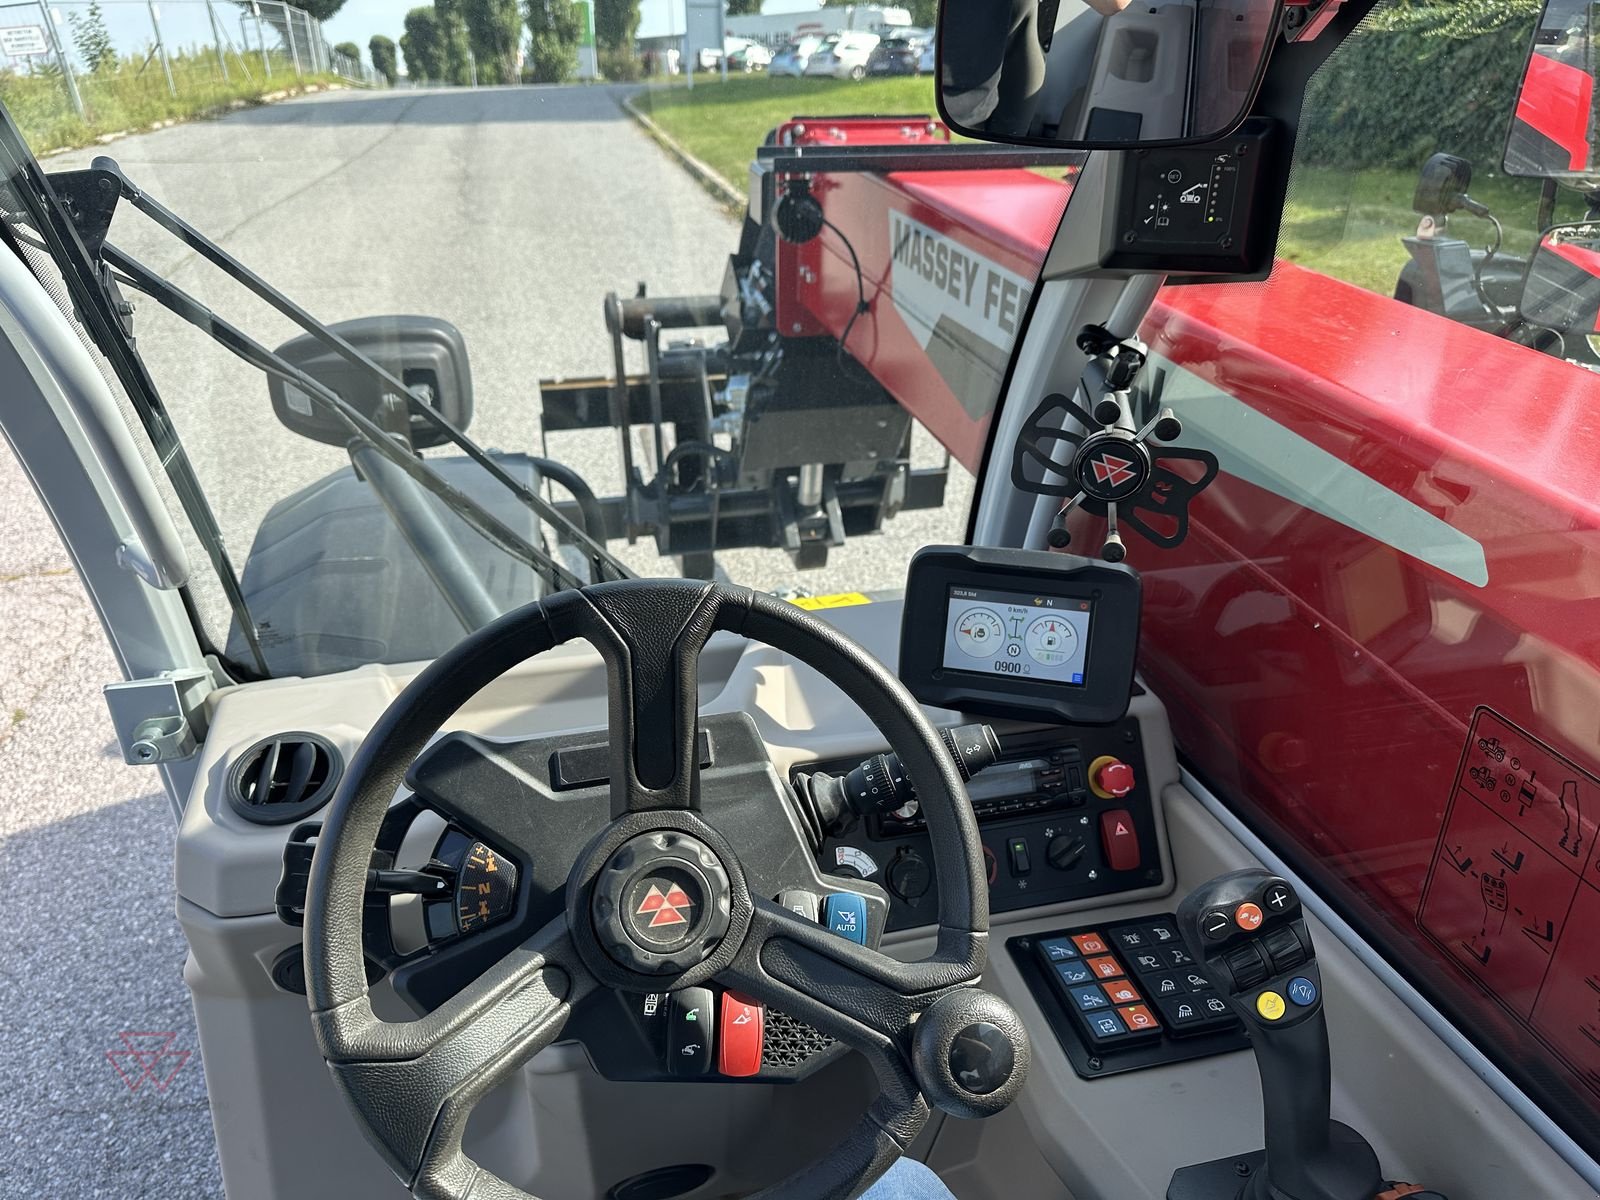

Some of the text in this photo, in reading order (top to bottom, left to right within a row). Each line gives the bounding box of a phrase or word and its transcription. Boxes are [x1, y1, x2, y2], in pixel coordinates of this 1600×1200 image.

[893, 219, 980, 309] MASSEY
[1046, 599, 1054, 607] N
[1013, 607, 1028, 615] km/h
[994, 660, 1021, 674] 0900
[479, 882, 490, 895] N
[836, 924, 856, 932] AUTO
